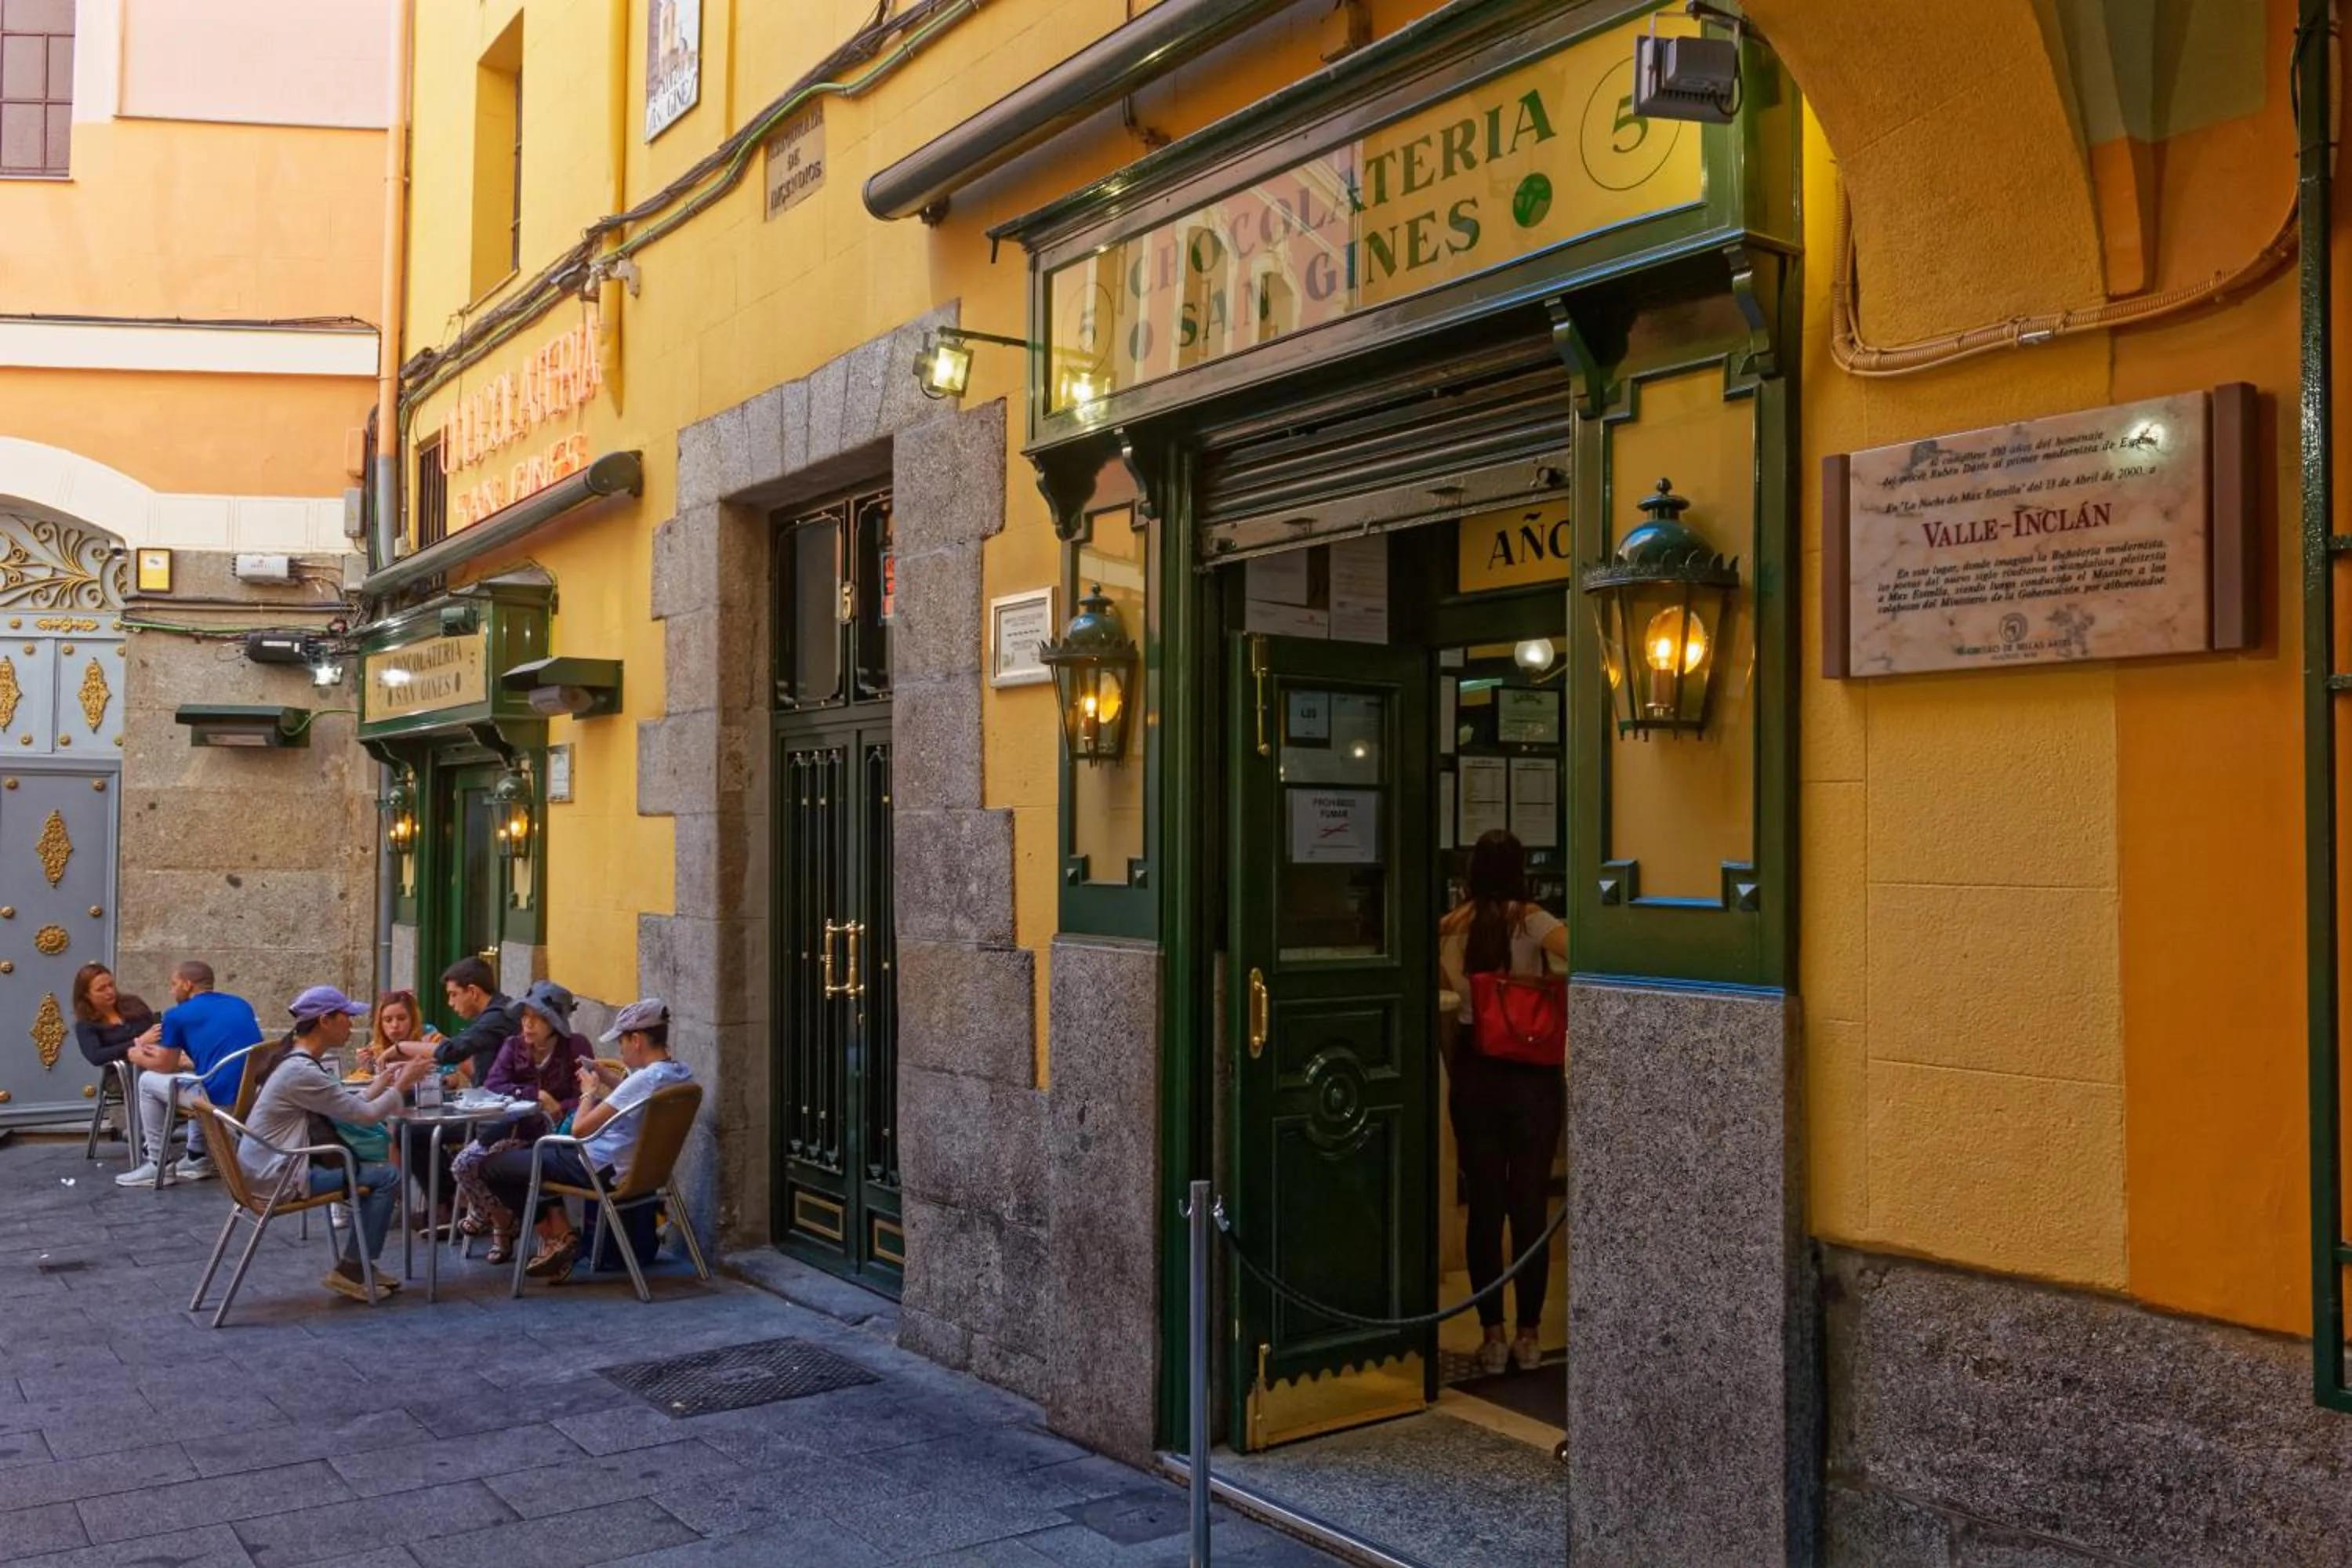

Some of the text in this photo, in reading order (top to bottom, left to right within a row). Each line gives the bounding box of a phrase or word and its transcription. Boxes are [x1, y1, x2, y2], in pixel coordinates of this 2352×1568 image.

[1613, 95, 1650, 153] 5
[1130, 89, 1556, 299] CHOCOLATERIA
[1178, 198, 1481, 347] SAN GINES
[2102, 440, 2115, 452] de
[2058, 477, 2071, 488] de
[2101, 470, 2114, 481] de
[2091, 567, 2133, 581] Maestro
